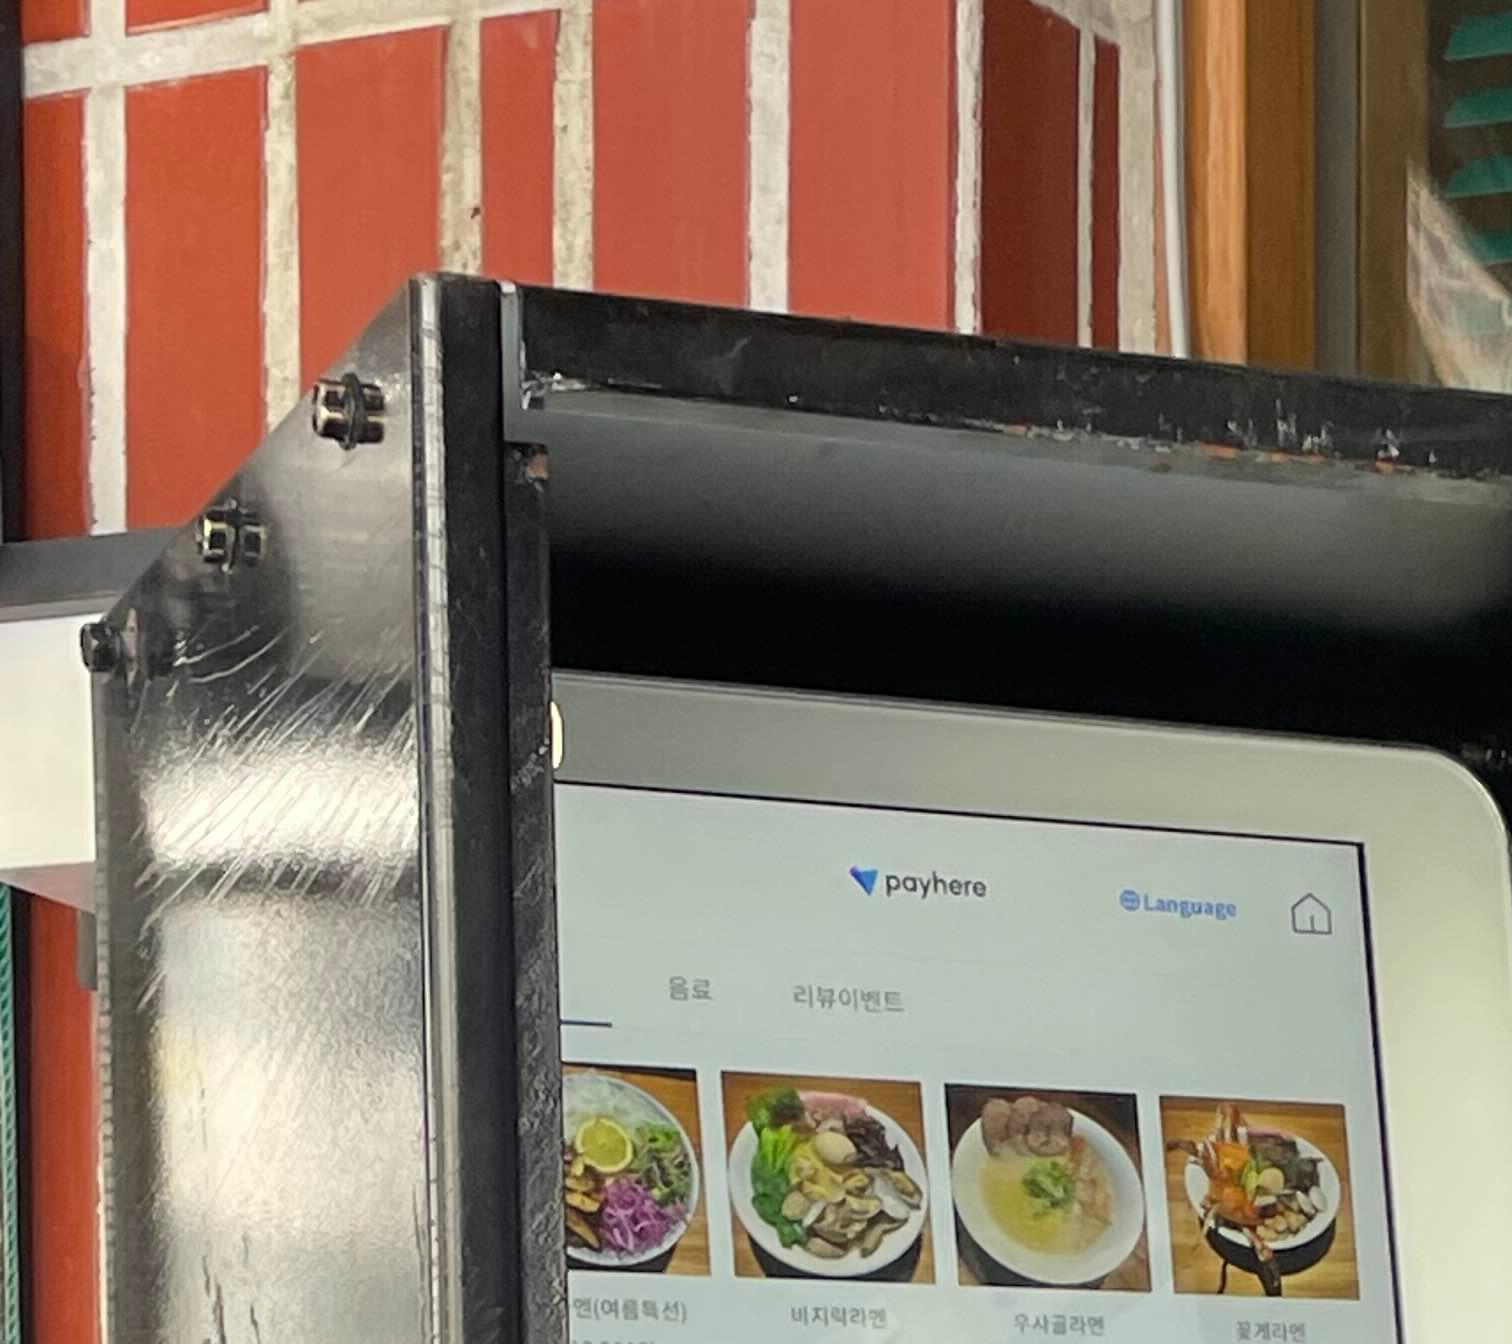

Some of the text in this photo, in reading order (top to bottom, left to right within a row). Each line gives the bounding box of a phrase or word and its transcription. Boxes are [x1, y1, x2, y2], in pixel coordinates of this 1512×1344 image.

[885, 869, 987, 899] payhere
[1143, 894, 1237, 921] Language
[667, 975, 712, 1002] 음료
[792, 983, 905, 1014] 리뷰이벤트
[1235, 1320, 1307, 1343] 꽃게라멘
